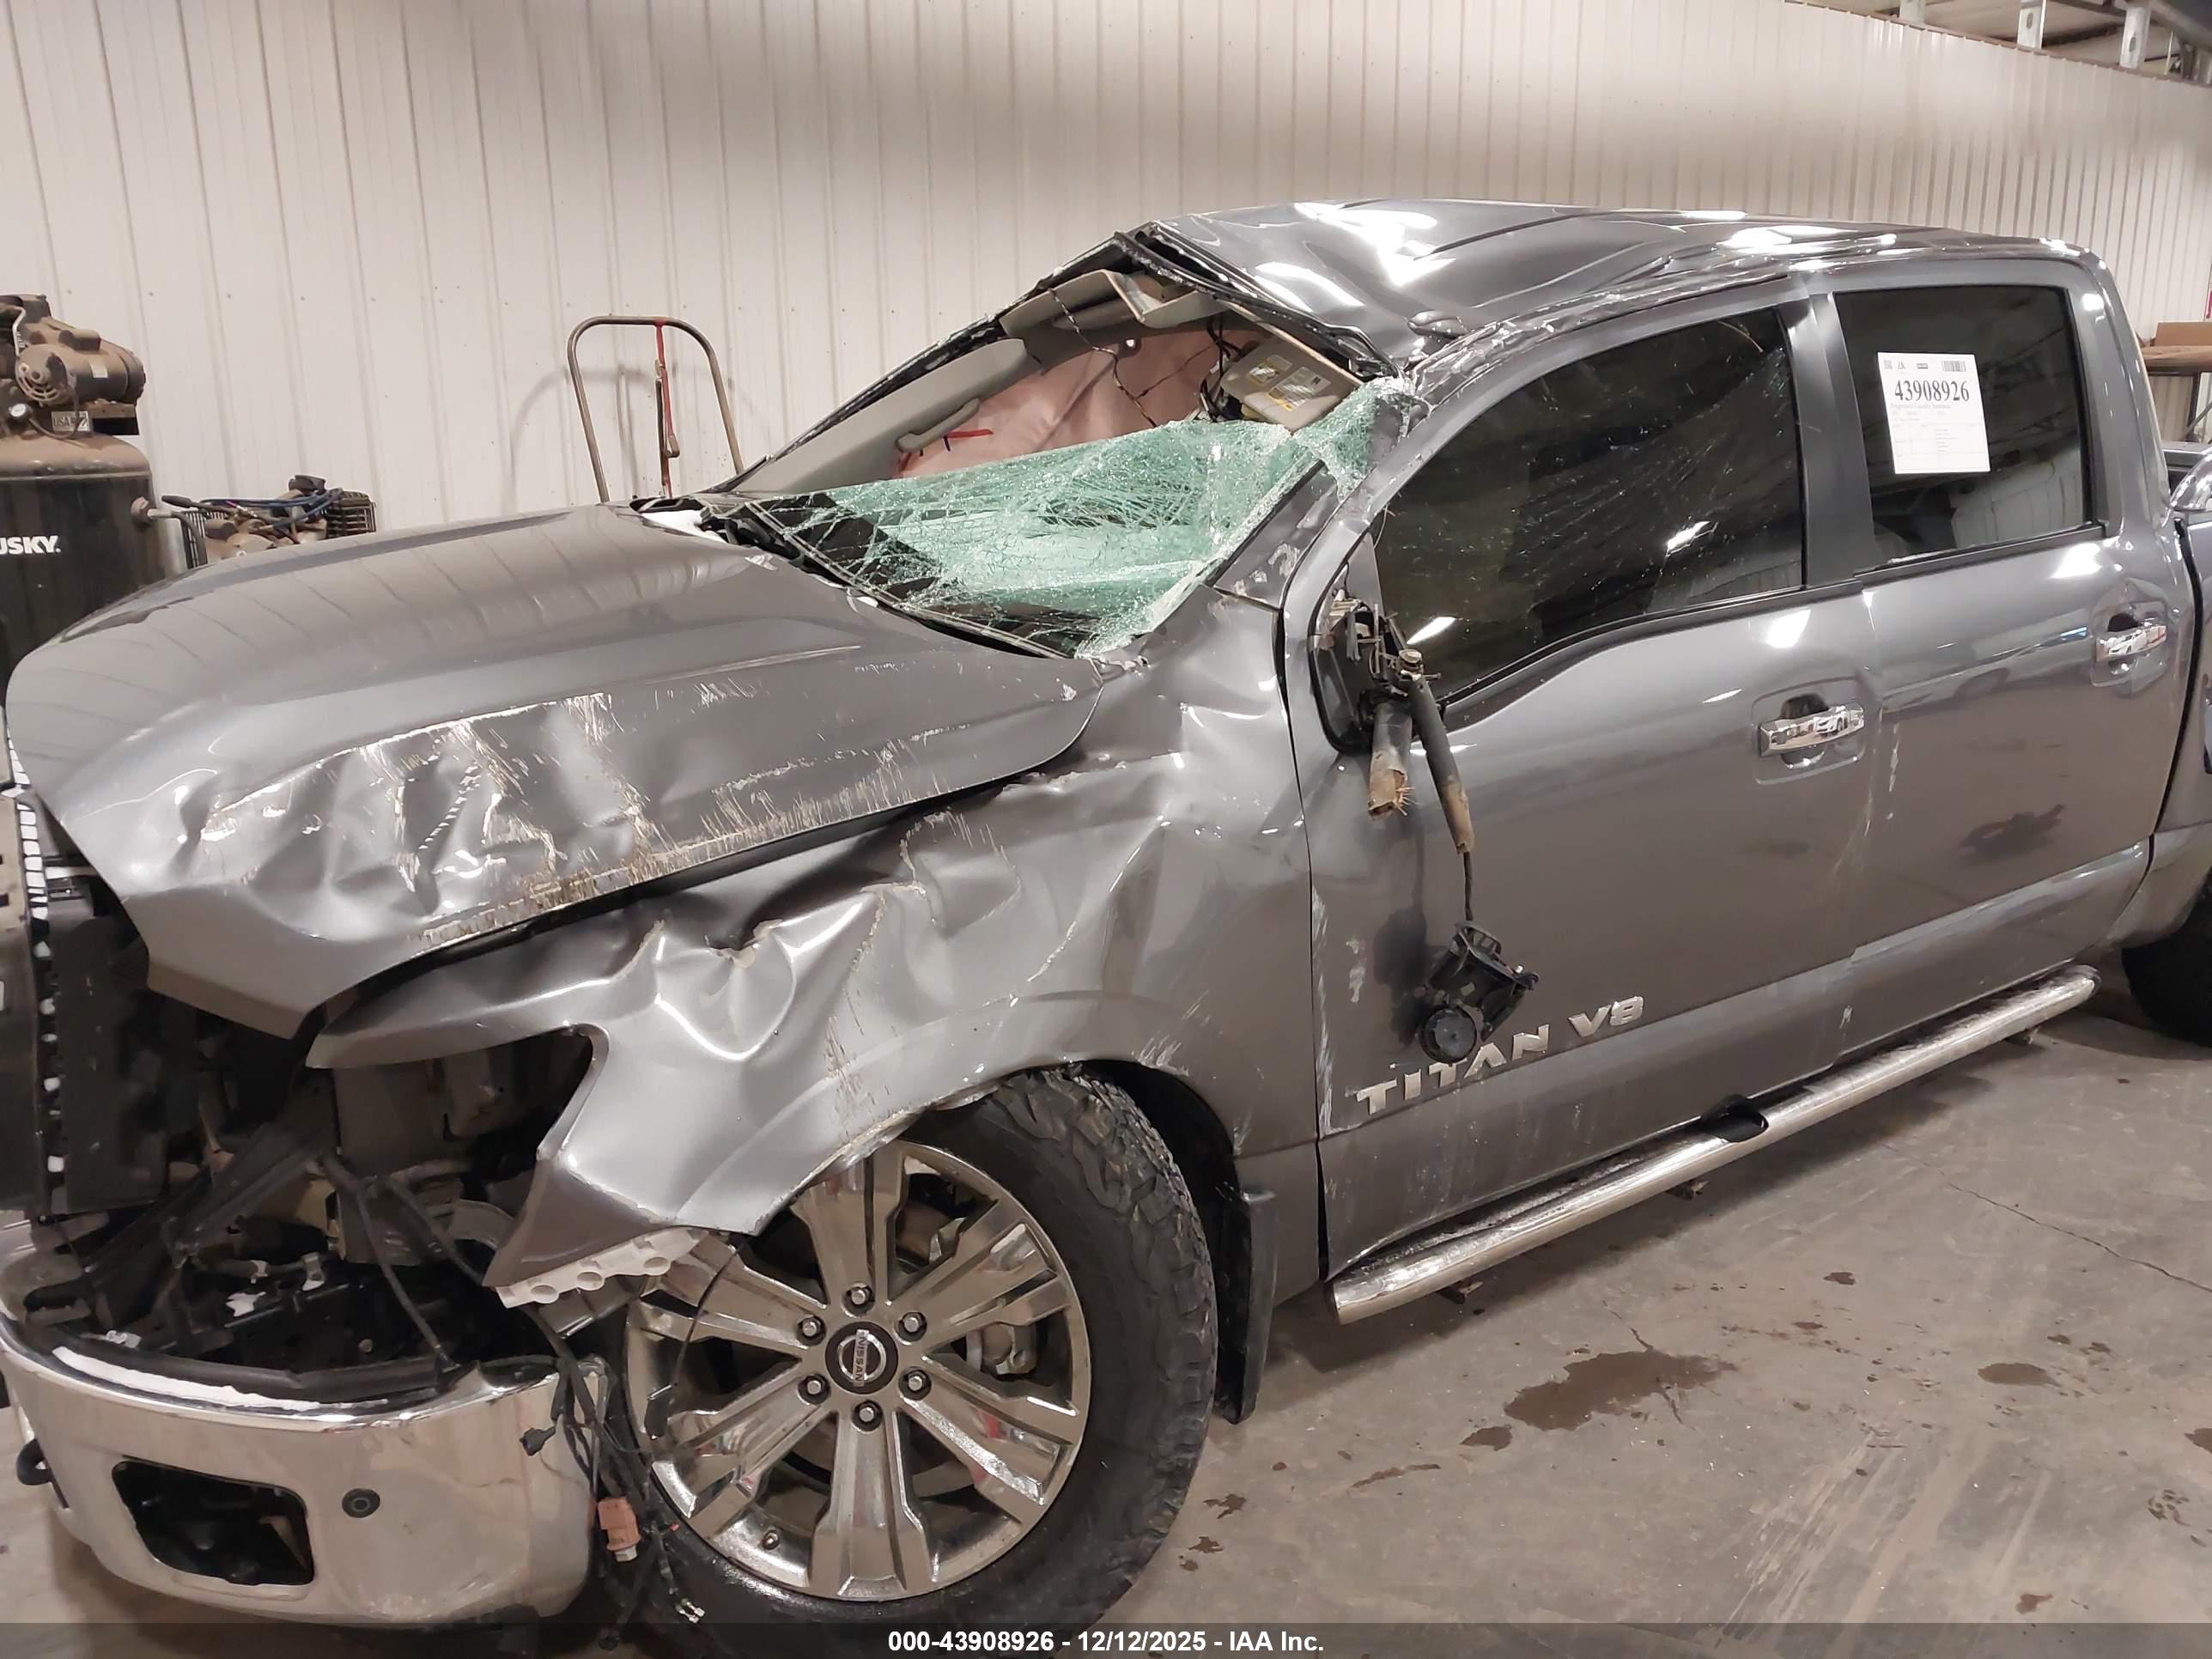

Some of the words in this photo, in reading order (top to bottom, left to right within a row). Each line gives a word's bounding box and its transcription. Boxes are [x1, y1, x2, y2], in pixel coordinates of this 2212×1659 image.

[1894, 380, 1970, 402] 43908926
[1357, 1024, 1550, 1115] TITAN
[1568, 996, 1644, 1038] V8
[854, 1337, 866, 1382] NISSAN
